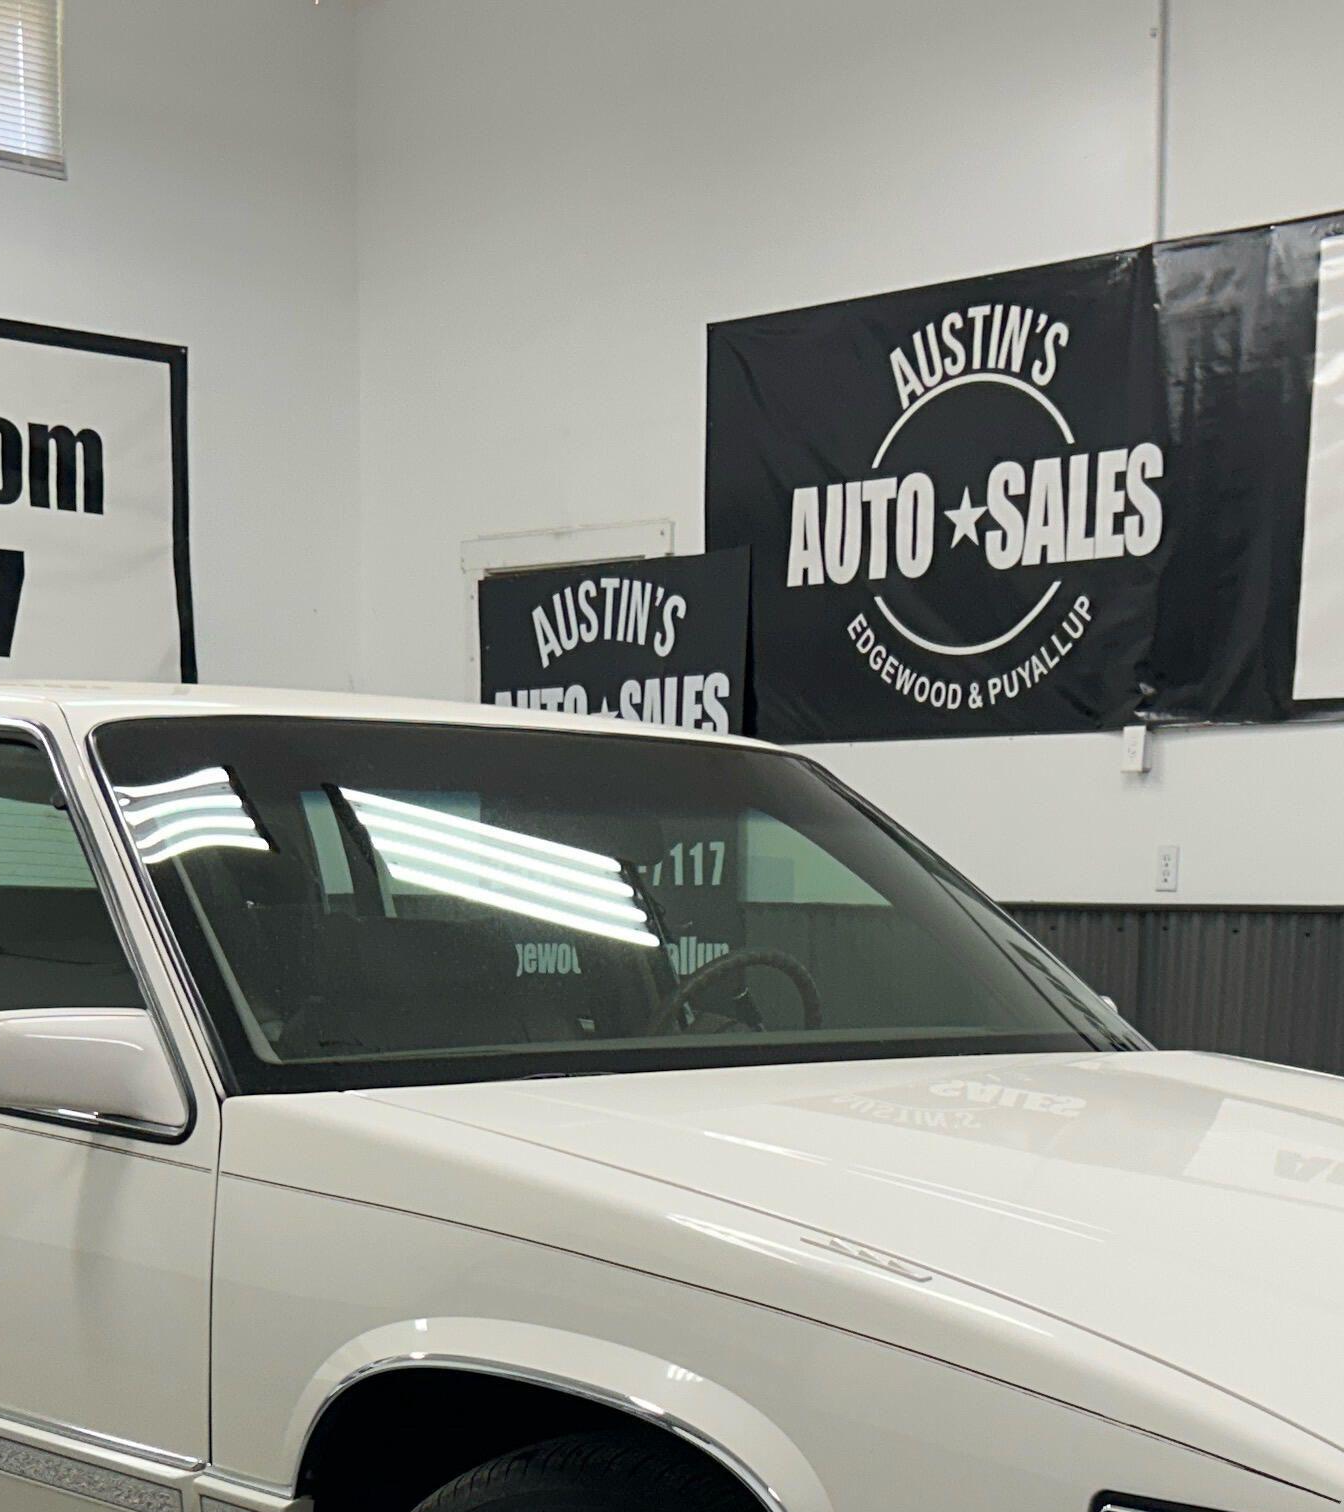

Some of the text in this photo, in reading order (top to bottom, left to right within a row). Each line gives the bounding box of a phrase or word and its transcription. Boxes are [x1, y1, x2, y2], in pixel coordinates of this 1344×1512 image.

[889, 304, 1069, 410] AUSTIN'S
[786, 442, 1164, 587] AUTO SALES
[532, 577, 687, 669] AUSTIN'S
[846, 595, 1092, 710] EDGEWOOD & PUYALLUP
[619, 672, 730, 736] SALES
